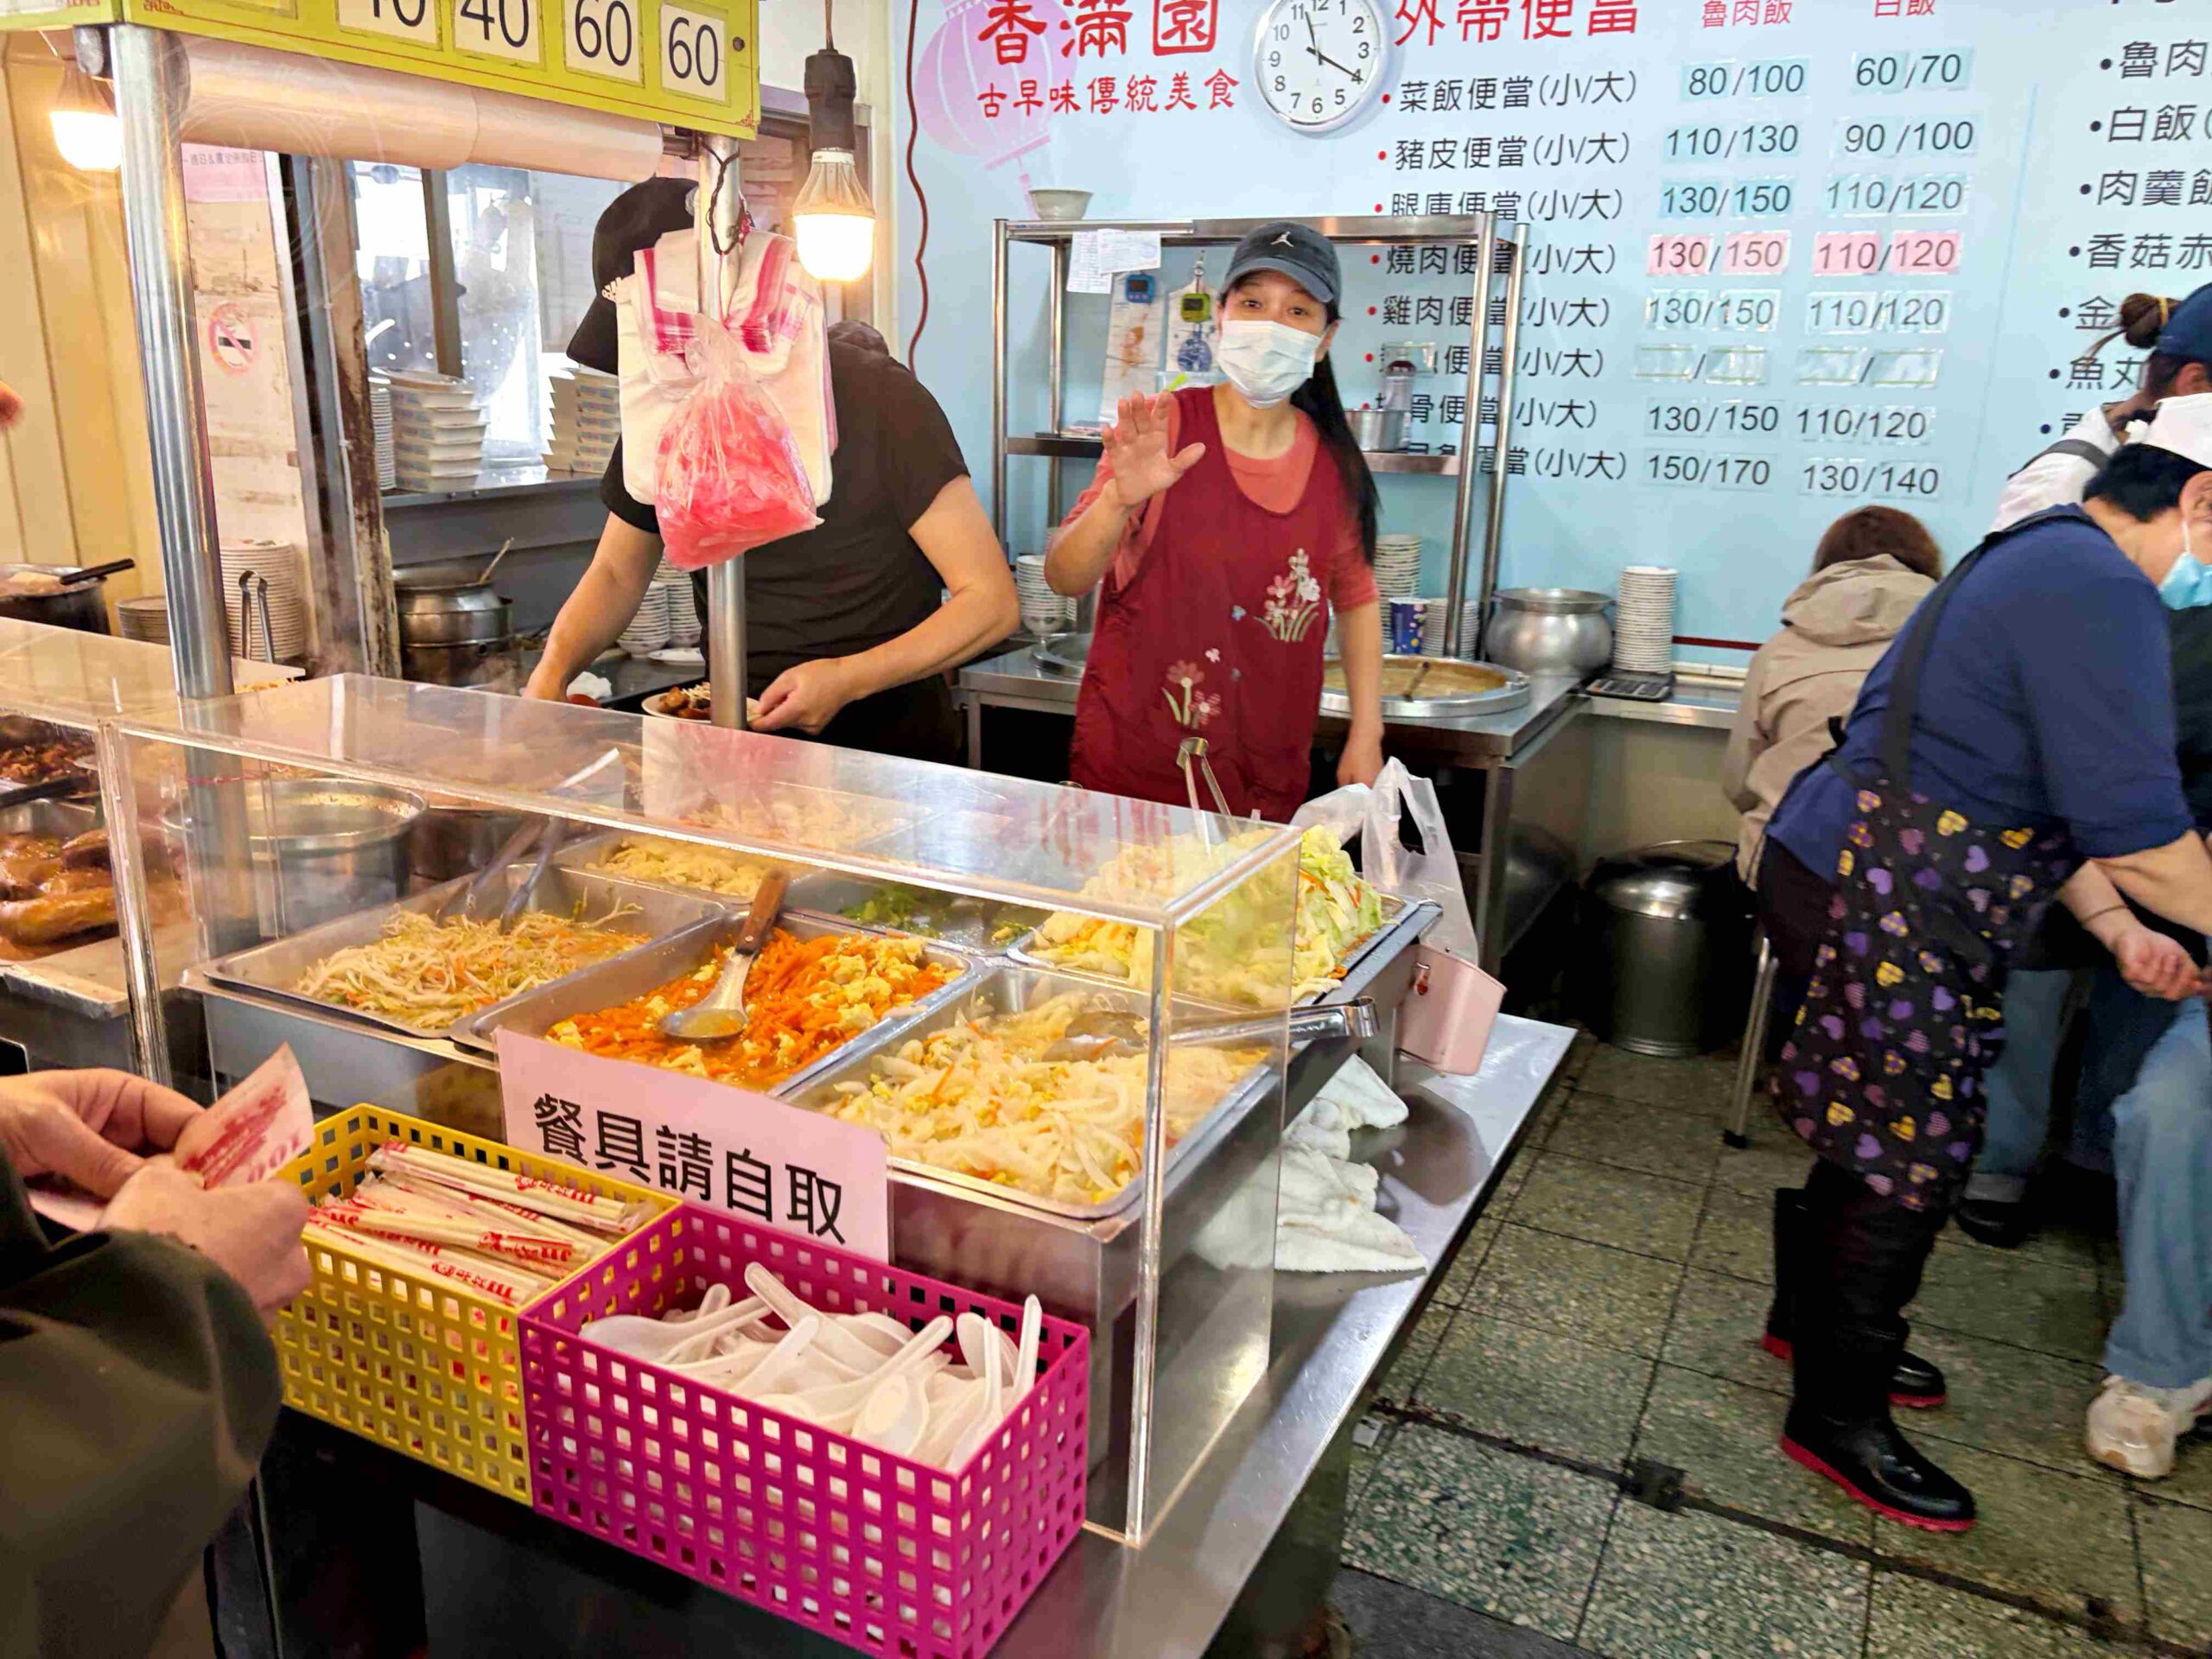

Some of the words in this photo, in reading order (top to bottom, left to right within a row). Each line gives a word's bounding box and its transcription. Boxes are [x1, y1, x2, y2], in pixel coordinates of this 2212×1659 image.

[460, 0, 529, 48] 40
[1291, 3, 1304, 20] 11
[1352, 16, 1364, 34] 2
[1395, 0, 1638, 46] 外帶便當
[1700, 0, 1792, 29] 魯肉飯
[575, 0, 632, 67] 60
[977, 0, 1218, 65] 香滿園
[1274, 24, 1290, 41] 10
[668, 16, 719, 86] 60
[1270, 51, 1281, 67] 9
[1357, 41, 1370, 59] 3
[2119, 40, 2212, 79] 魯肉
[1274, 75, 1286, 92] 8
[1351, 69, 1363, 85] 4
[1688, 65, 1805, 95] 80/100
[1855, 54, 1961, 89] 60/70
[977, 68, 1240, 118] 古早味傳統美食
[1291, 92, 1301, 109] 7
[1312, 98, 1323, 113] 6
[1335, 89, 1345, 105] 5
[1399, 71, 1637, 112] 菜飯便當(小/大)
[1395, 132, 1630, 170] 豬皮便當(小/大)
[1667, 125, 1799, 157] 110/130
[1844, 121, 1974, 154] 90/100
[1663, 185, 1790, 215] 130/150
[1827, 181, 1963, 213] 110/120
[1386, 244, 1616, 275] 燒肉便當小/大)
[1651, 240, 1783, 272] 130/150
[1817, 238, 1956, 271] 110/120
[1382, 296, 1609, 327] 雞肉便當小/大)
[1649, 298, 1774, 325] 130/150
[1809, 298, 1945, 327] 110/120
[1648, 405, 1779, 433] 130/150
[1796, 408, 1927, 438] 110/120
[1647, 454, 1770, 485] 150/170
[1802, 465, 1939, 494] 130/140
[533, 1093, 846, 1244] 餐具請自取
